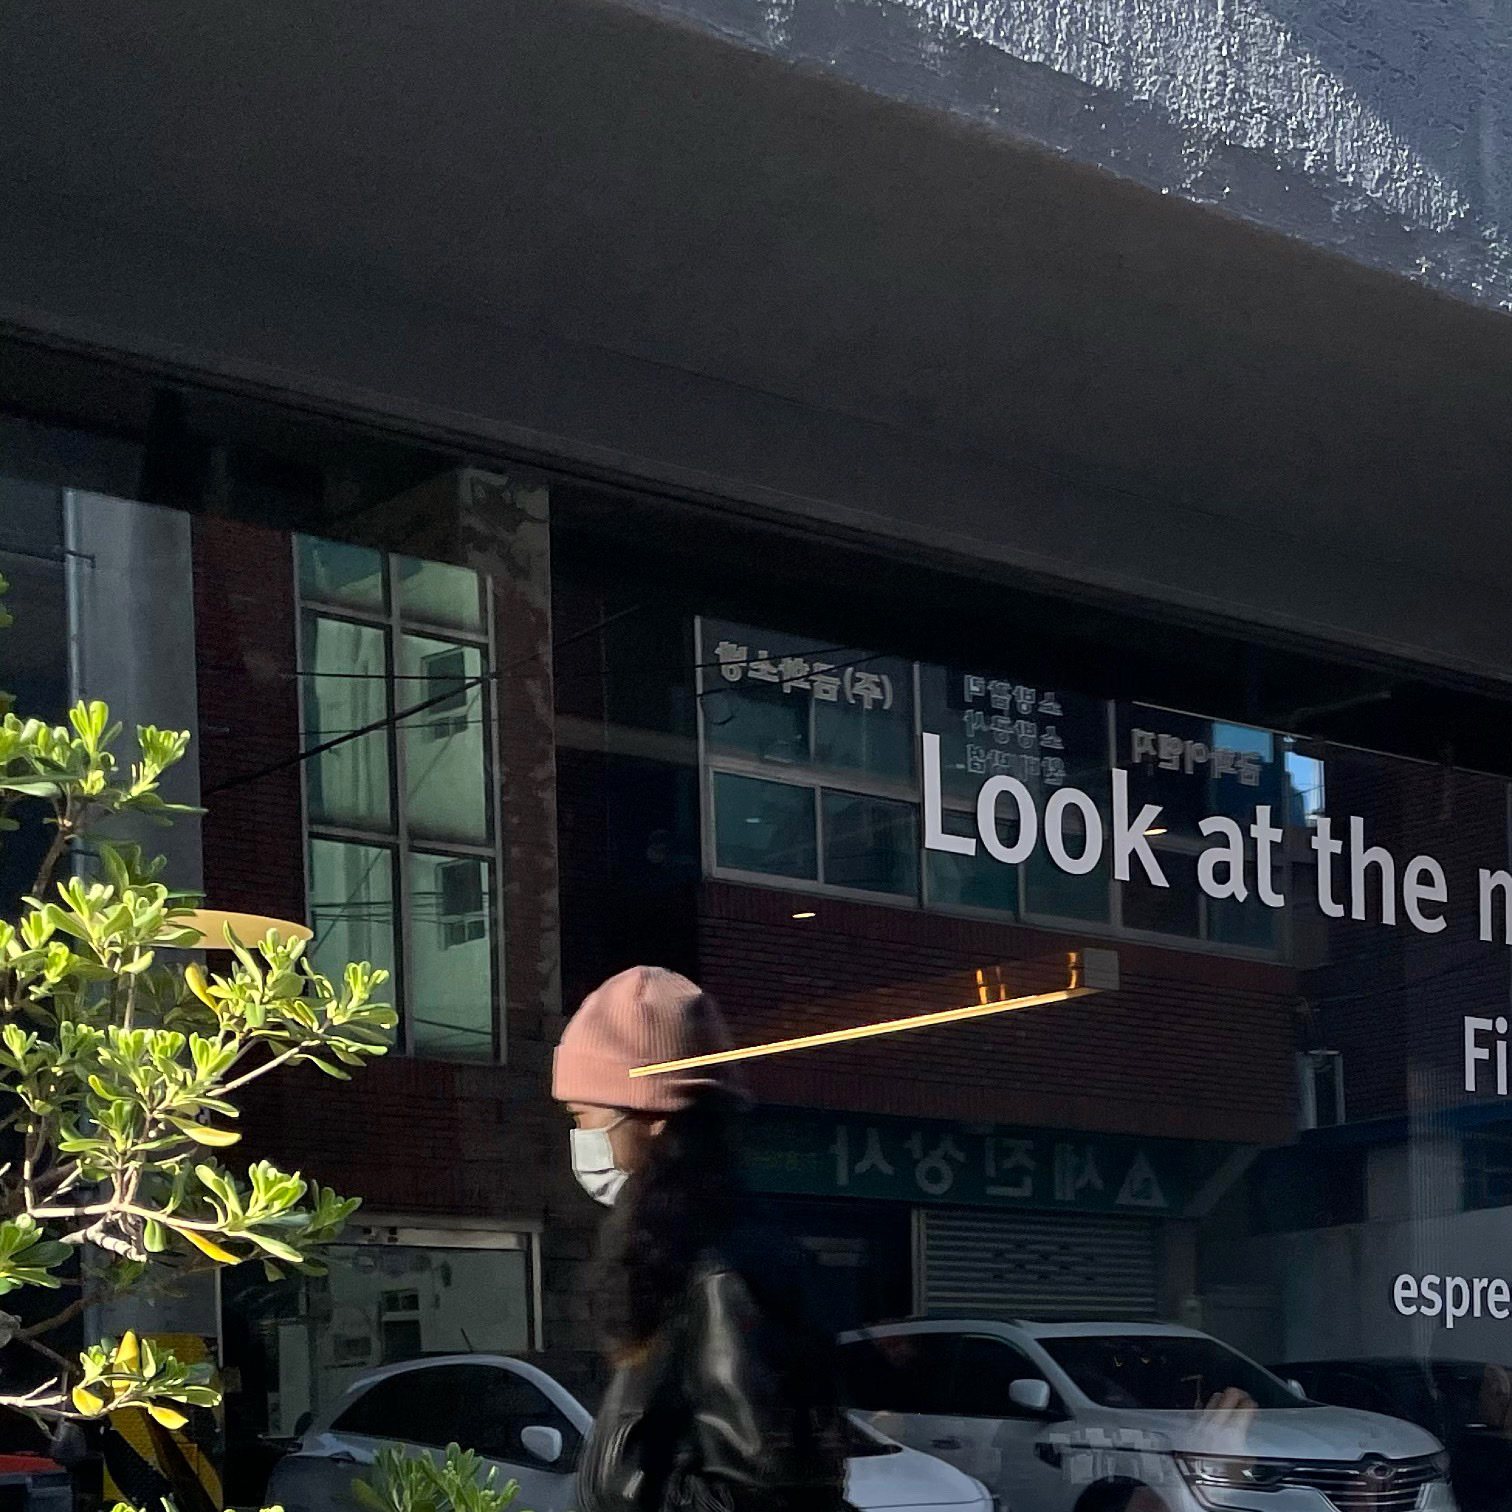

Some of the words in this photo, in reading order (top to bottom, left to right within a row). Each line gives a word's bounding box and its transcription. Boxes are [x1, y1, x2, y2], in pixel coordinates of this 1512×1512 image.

[922, 732, 1170, 888] Look
[1197, 805, 1285, 908] at
[1311, 814, 1448, 933] the
